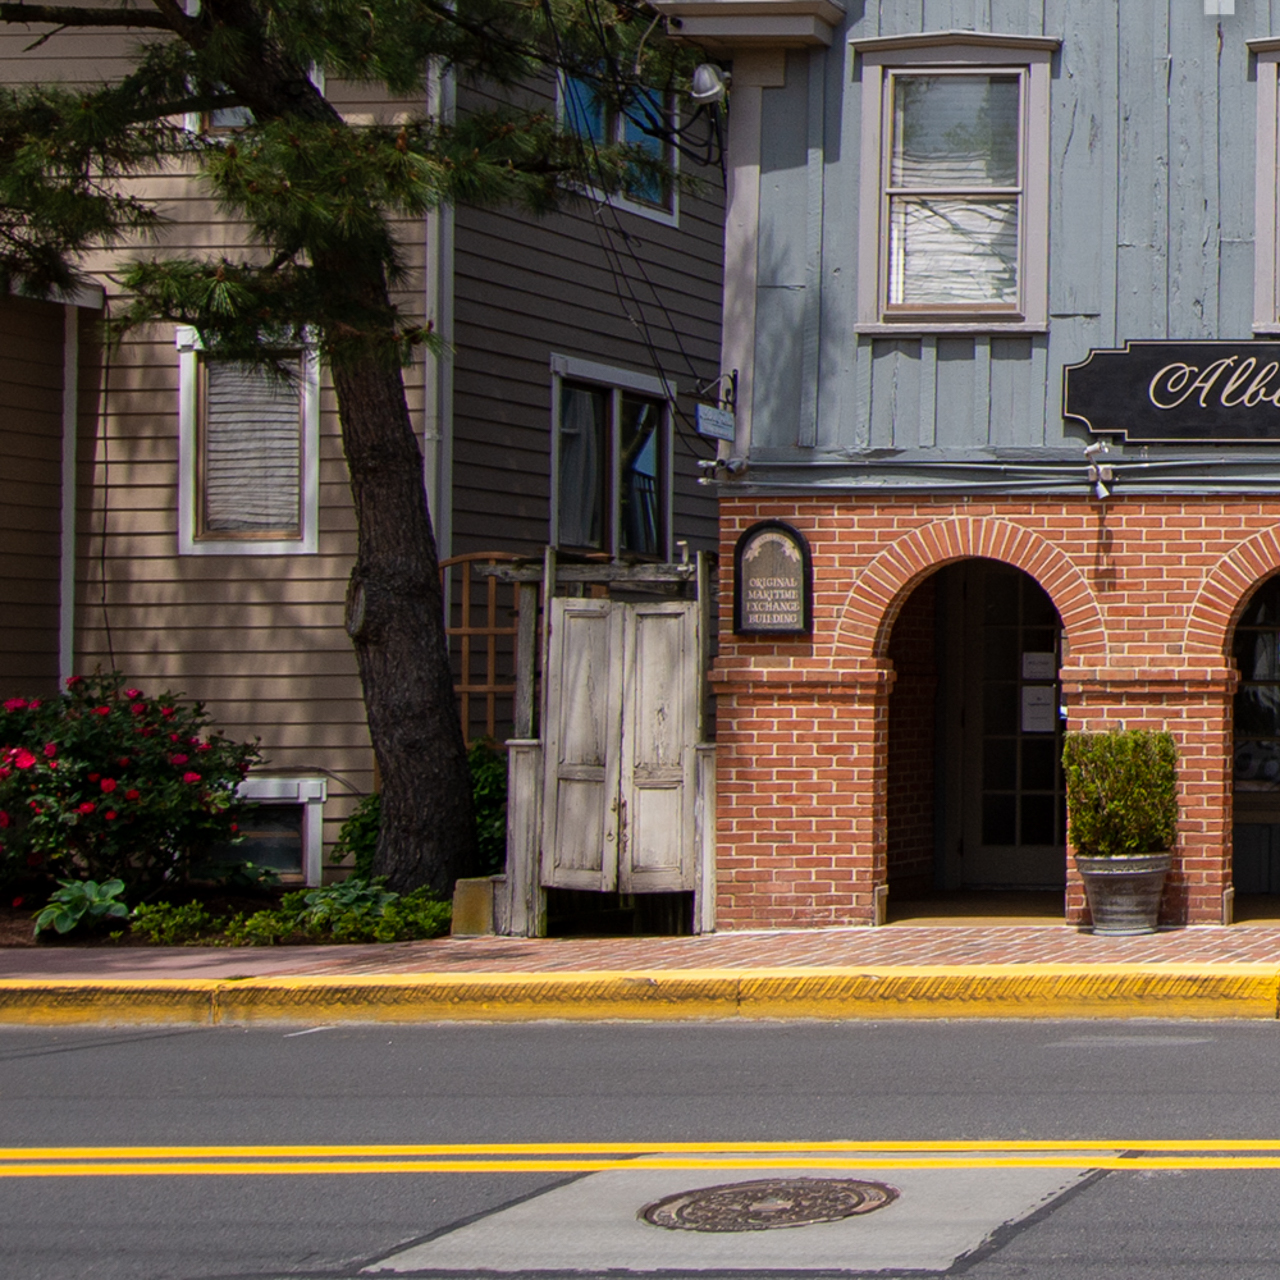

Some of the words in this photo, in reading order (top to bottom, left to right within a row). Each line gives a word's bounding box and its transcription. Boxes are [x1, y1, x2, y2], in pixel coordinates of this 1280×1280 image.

[749, 577, 797, 589] ORIGINAL
[748, 589, 798, 601] MARITIME
[746, 601, 800, 611] EXCHANGE
[749, 614, 797, 623] BUILDING
